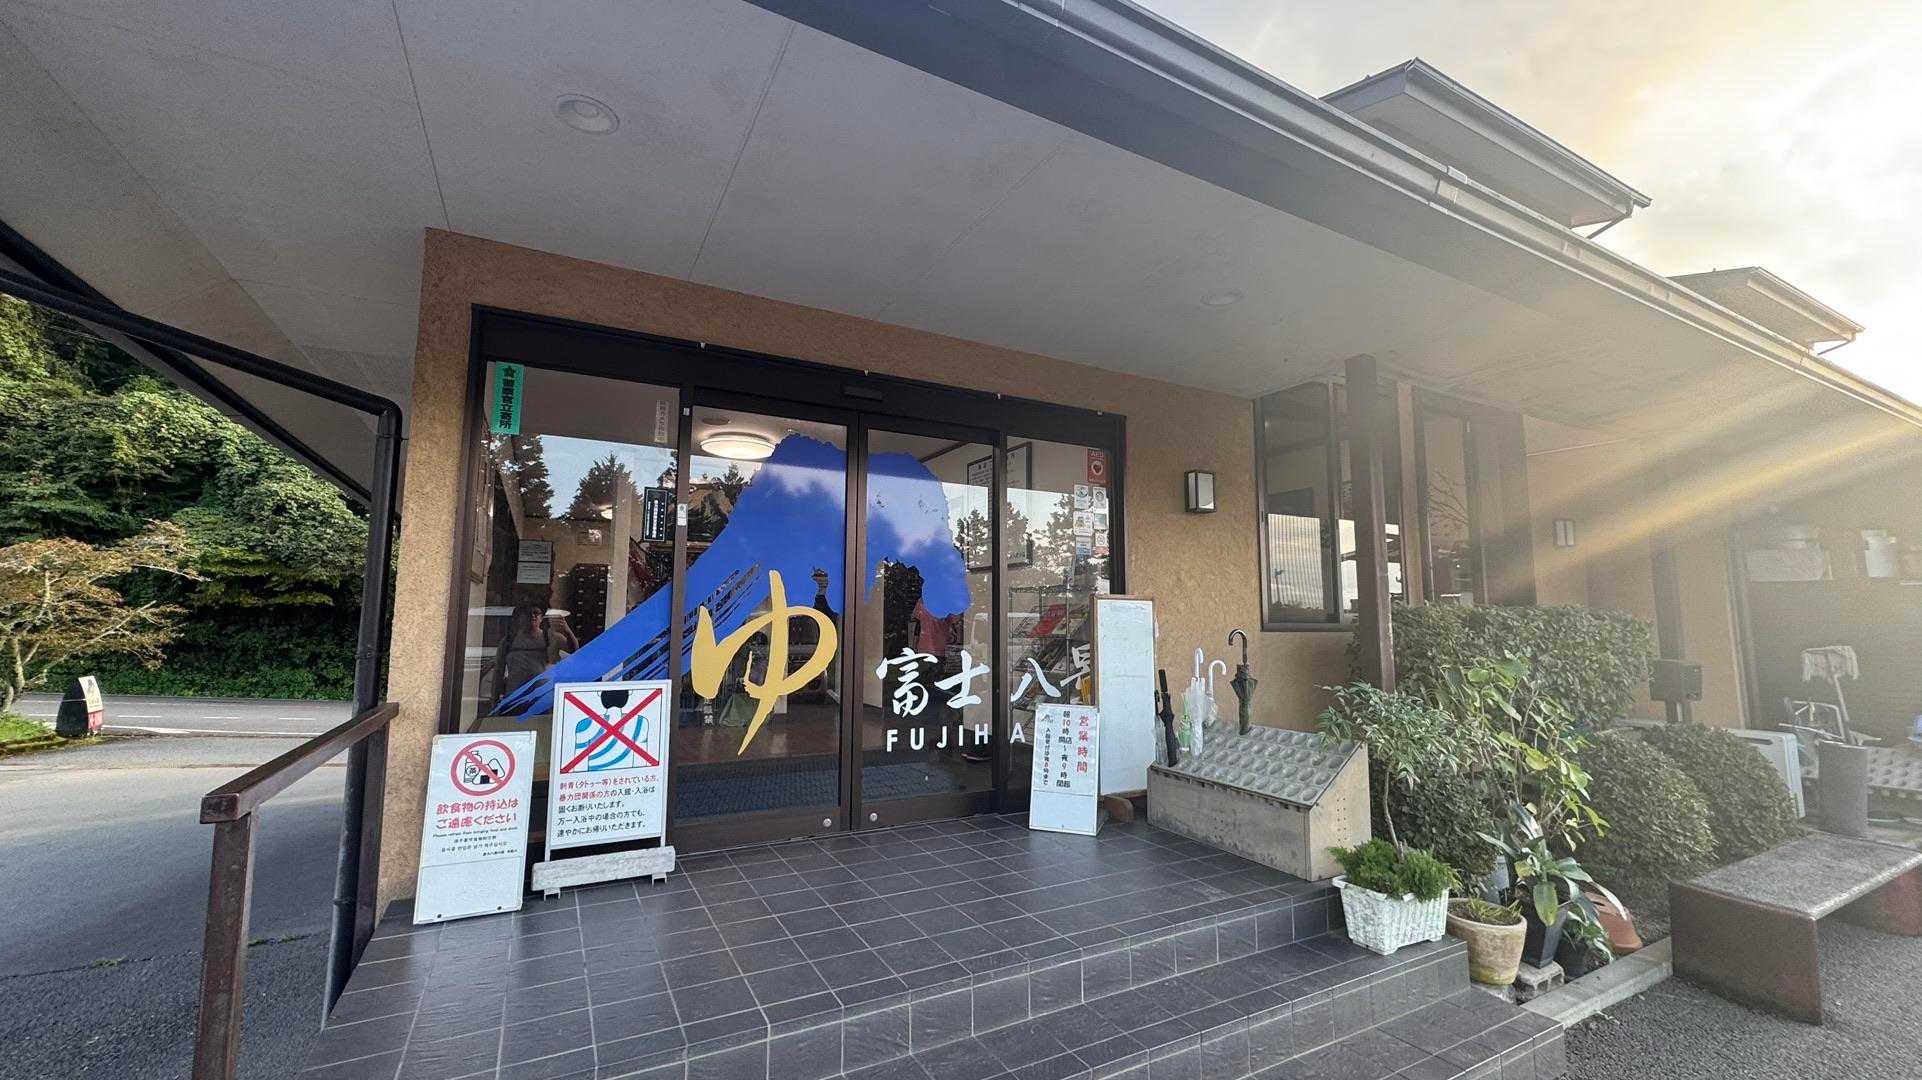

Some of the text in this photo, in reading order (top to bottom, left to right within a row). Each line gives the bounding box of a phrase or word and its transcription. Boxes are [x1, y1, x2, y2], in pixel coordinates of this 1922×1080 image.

[691, 570, 838, 755] ゆ
[1076, 714, 1089, 774] 営業時間
[436, 798, 519, 815] 飲食物の持込は
[436, 812, 517, 830] ご遠慮ください
